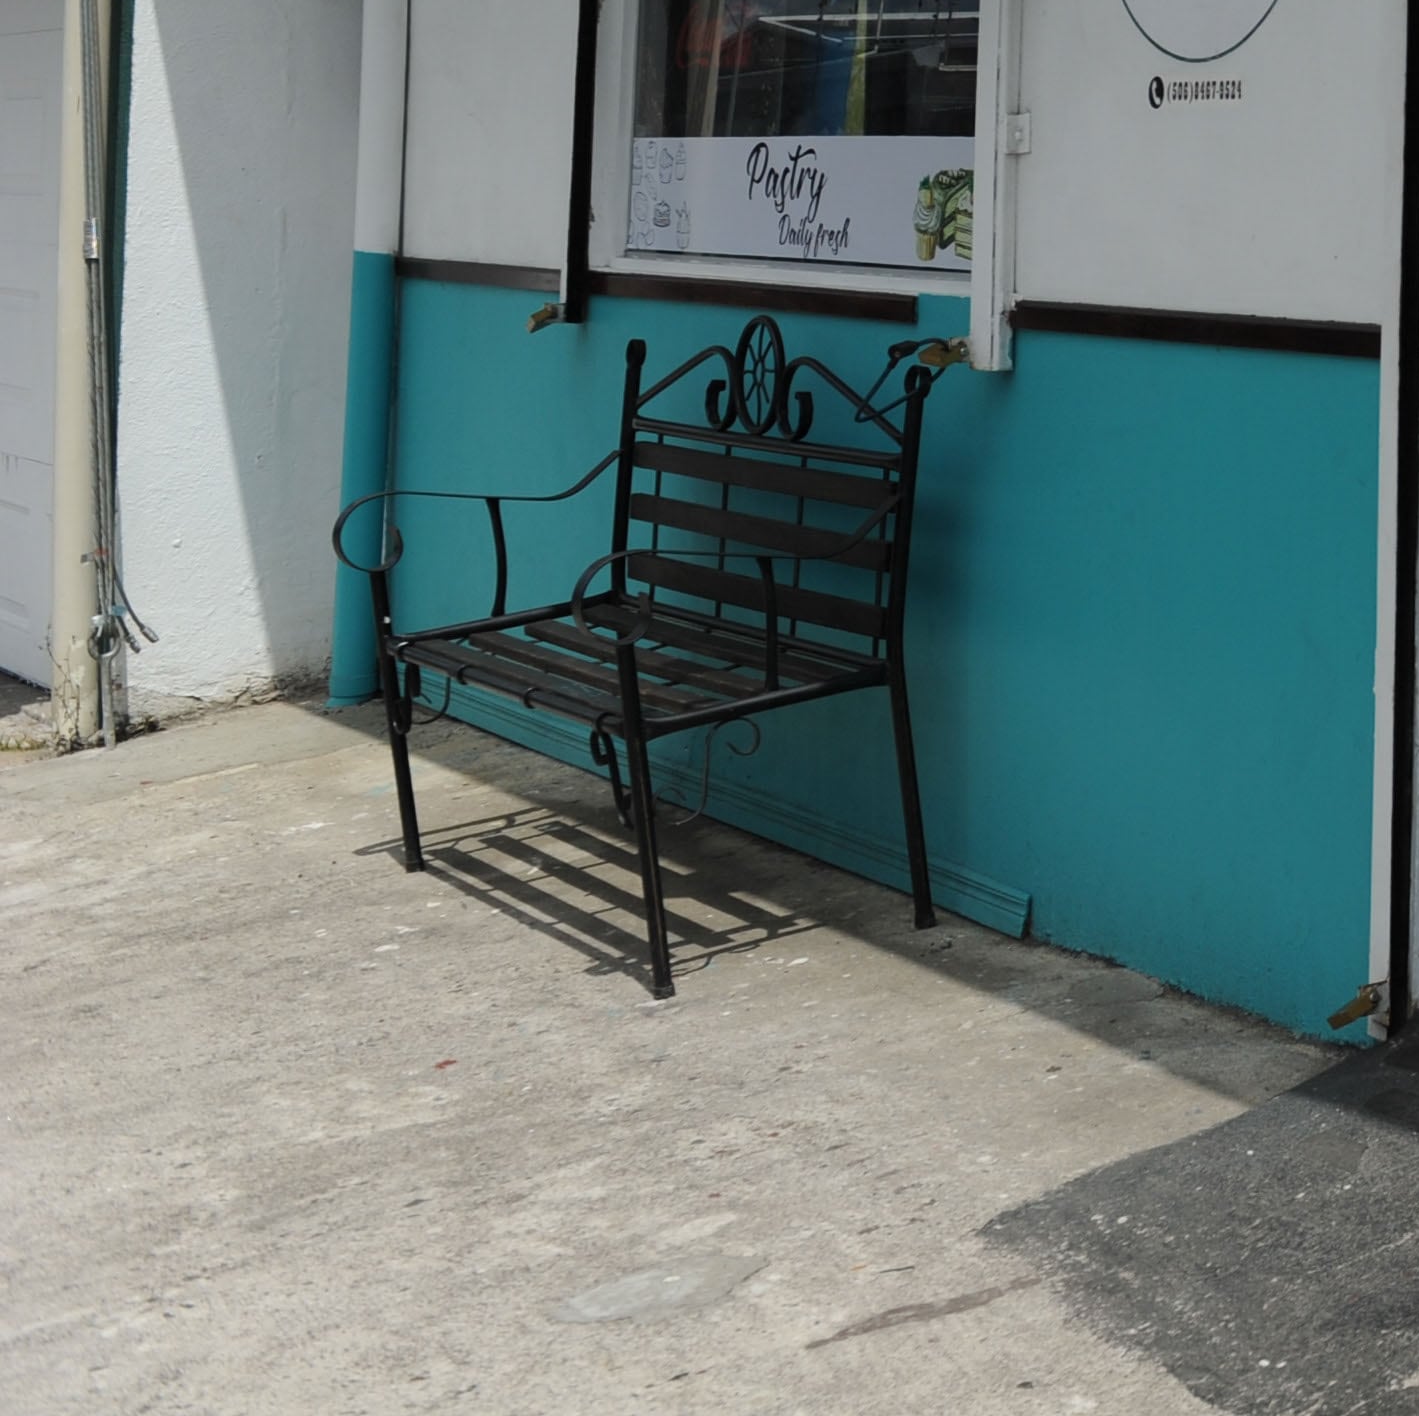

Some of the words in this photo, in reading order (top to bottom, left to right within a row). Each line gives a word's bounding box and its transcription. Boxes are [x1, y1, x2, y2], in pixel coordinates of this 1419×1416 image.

[747, 141, 828, 224] Pastry
[778, 214, 812, 258] Daily
[812, 217, 850, 257] fresh
